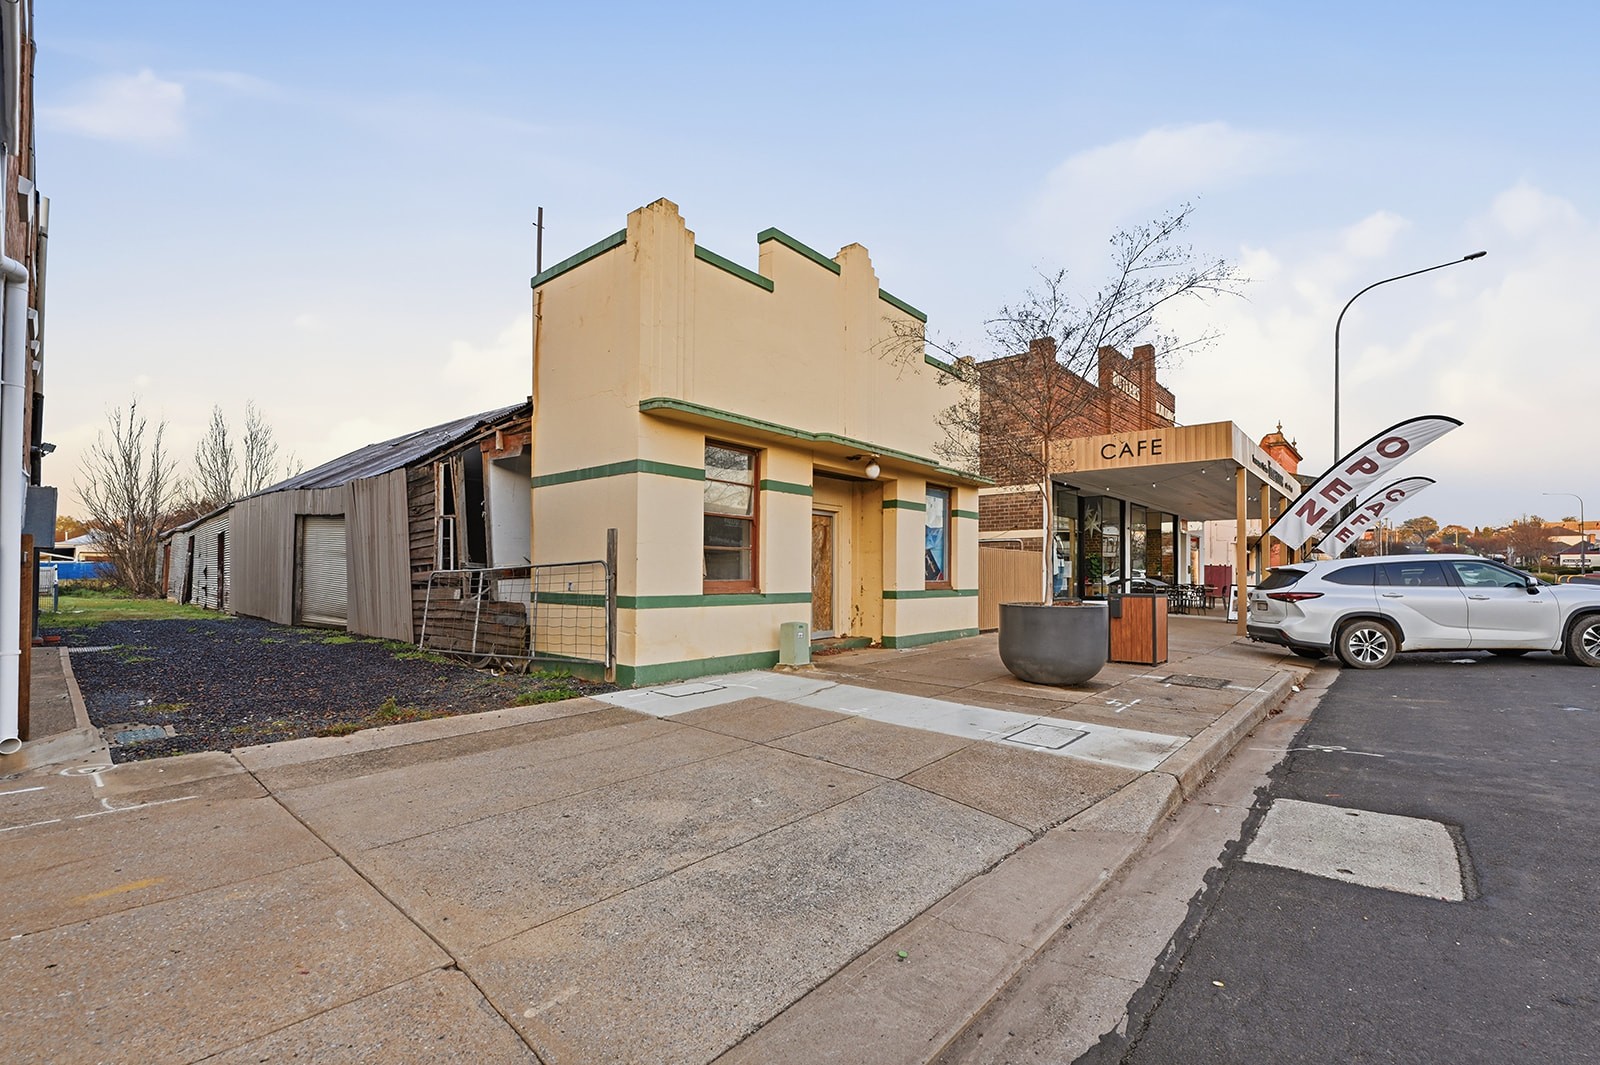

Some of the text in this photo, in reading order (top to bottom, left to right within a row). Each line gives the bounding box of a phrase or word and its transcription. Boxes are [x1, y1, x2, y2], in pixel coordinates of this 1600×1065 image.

[1101, 438, 1162, 459] CAFE
[1295, 436, 1410, 526] OPEN
[1335, 489, 1406, 543] CAFE
